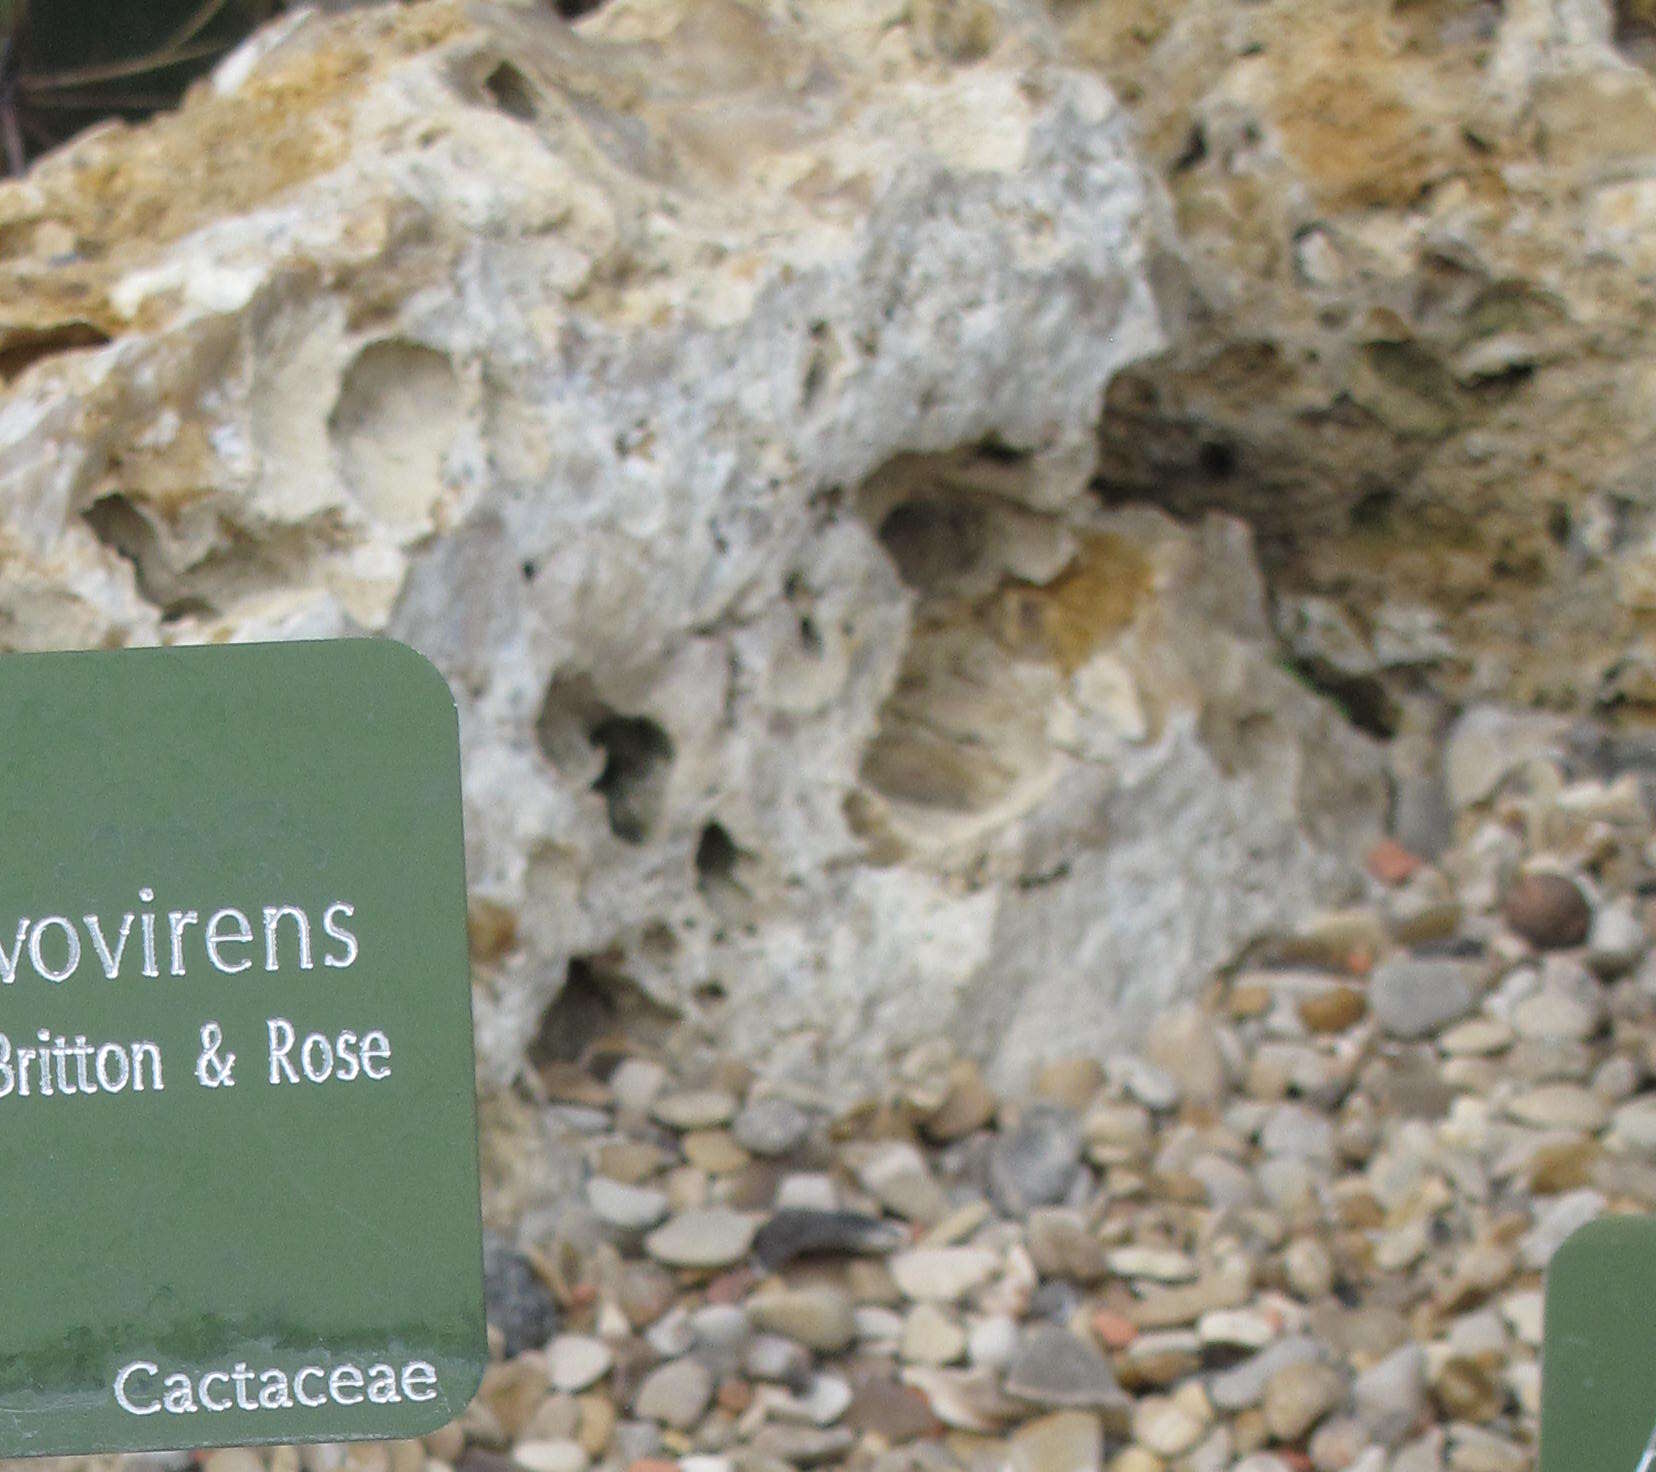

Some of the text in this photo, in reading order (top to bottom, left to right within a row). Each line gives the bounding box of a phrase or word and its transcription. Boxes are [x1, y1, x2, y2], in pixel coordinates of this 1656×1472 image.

[194, 1019, 238, 1089] &
[266, 1017, 393, 1085] Rose
[113, 1358, 439, 1417] Cactaceae
